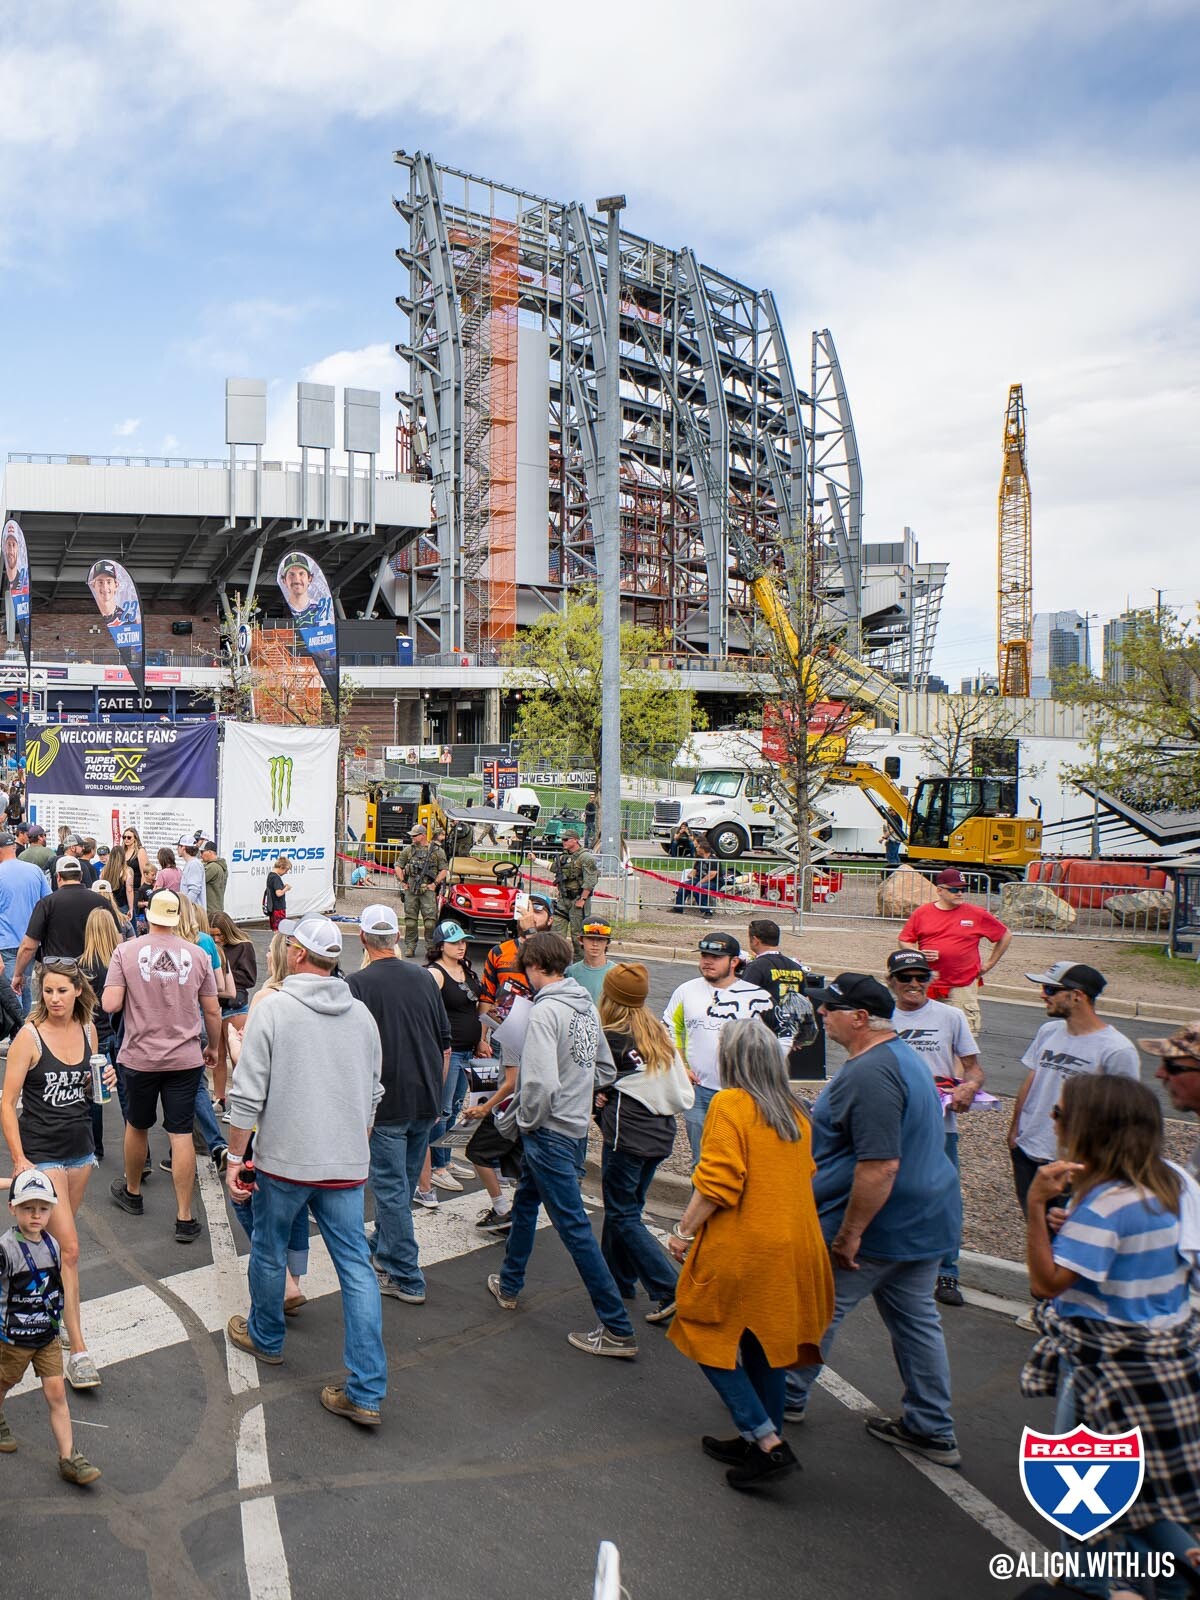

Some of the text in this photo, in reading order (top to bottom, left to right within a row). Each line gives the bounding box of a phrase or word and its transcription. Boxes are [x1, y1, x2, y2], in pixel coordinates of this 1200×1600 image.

[121, 600, 138, 622] 23
[318, 597, 332, 622] 21
[117, 632, 140, 644] SEXTON
[308, 635, 334, 646] ANDERSON
[98, 698, 152, 709] GATE 10
[60, 730, 177, 744] WELCOME RACE FANS
[254, 819, 304, 835] MONSTER
[1040, 1050, 1092, 1064] MF
